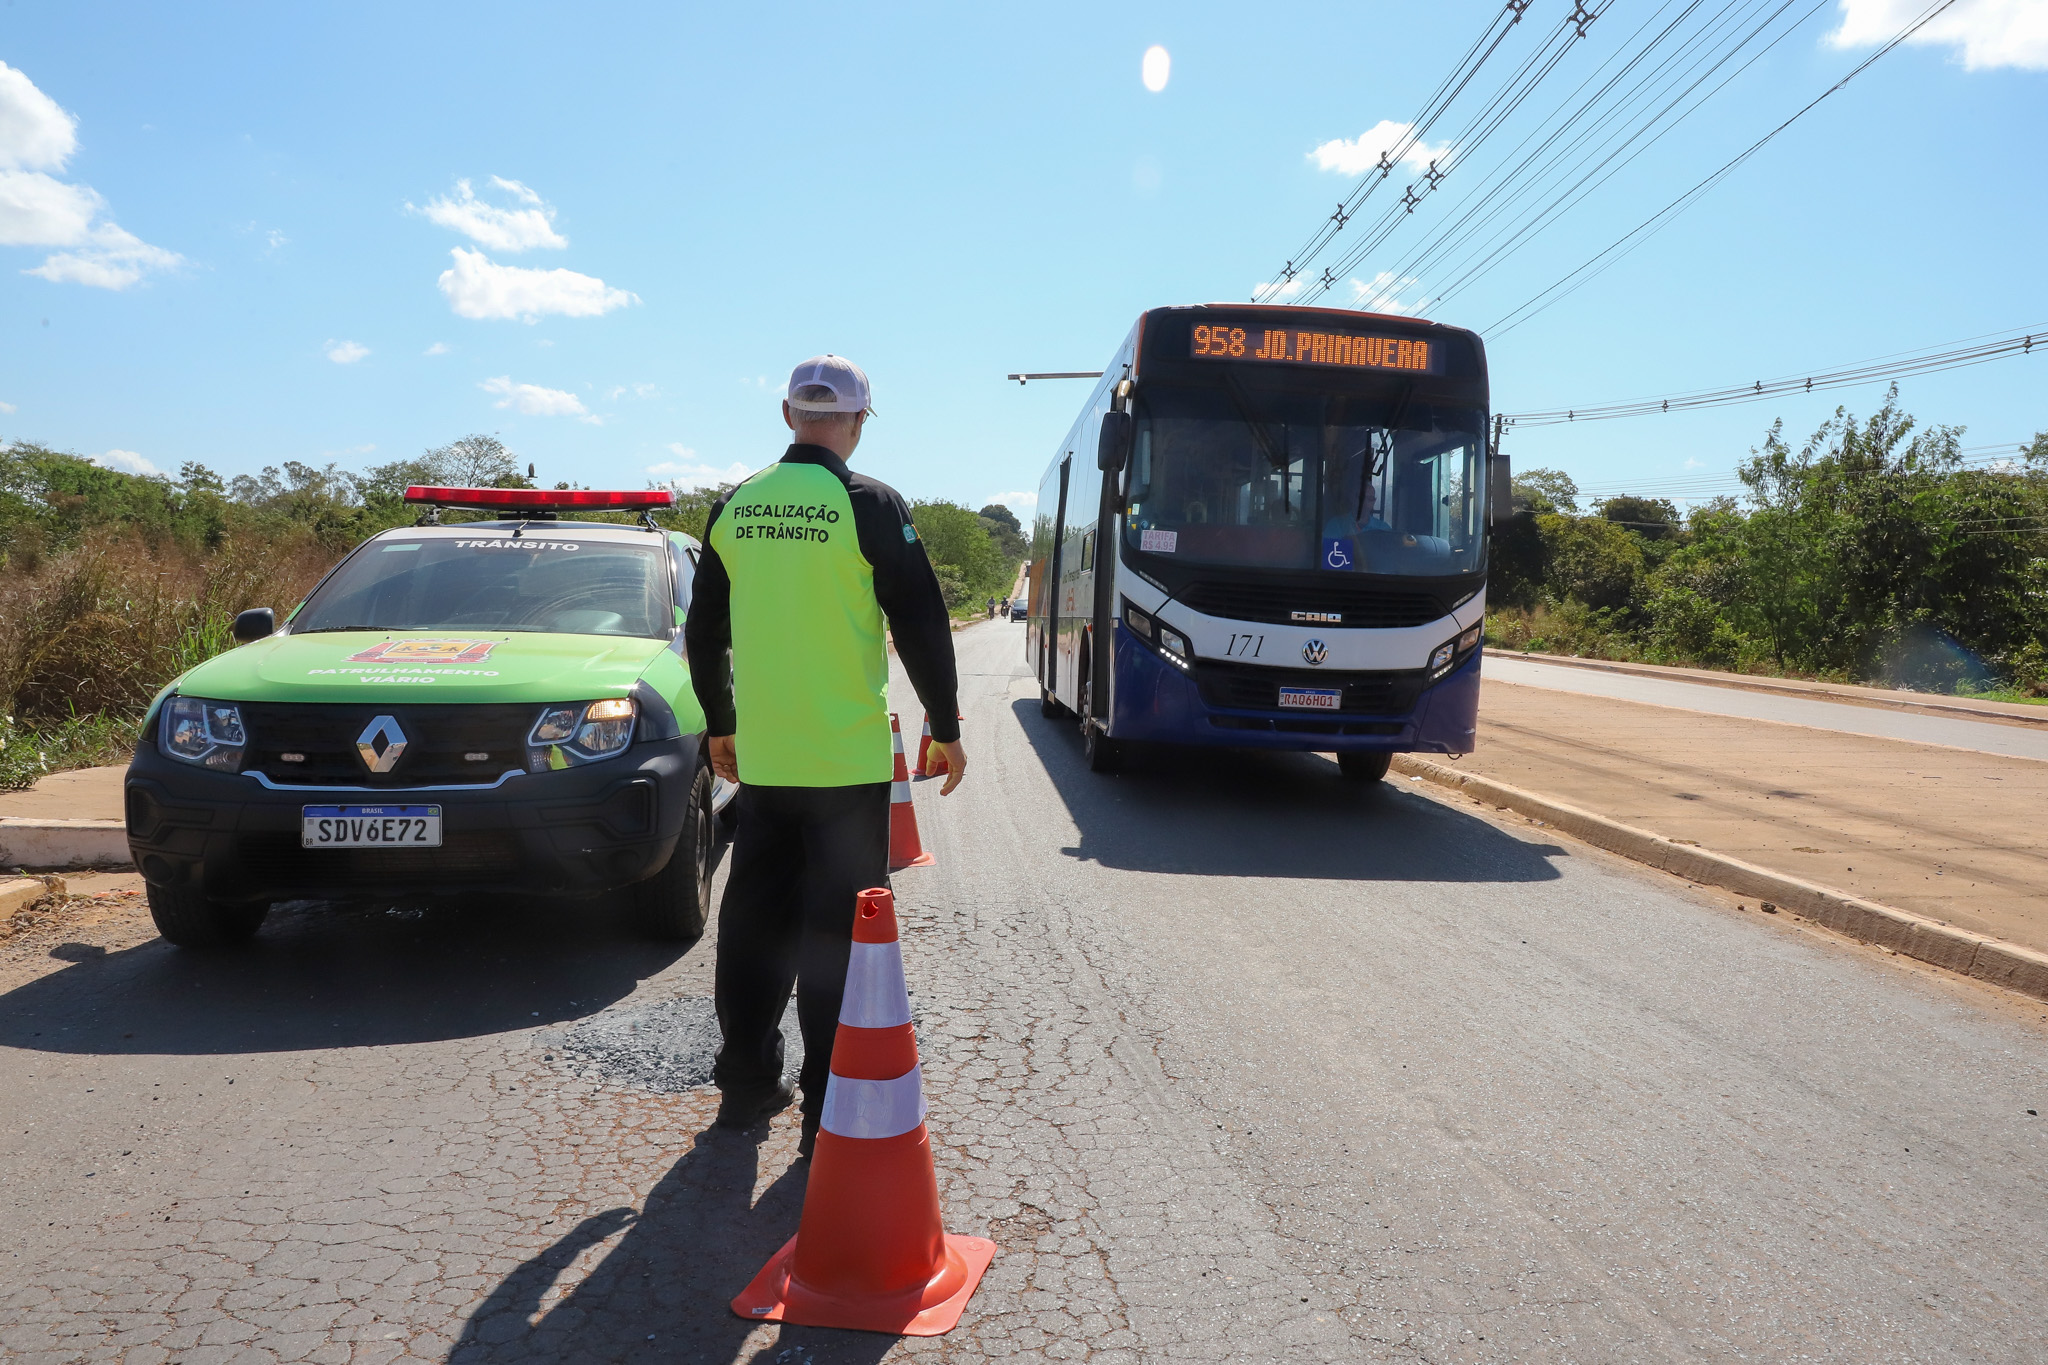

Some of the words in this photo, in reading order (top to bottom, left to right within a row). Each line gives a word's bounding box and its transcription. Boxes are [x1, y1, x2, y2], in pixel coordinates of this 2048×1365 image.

[1194, 325, 1247, 357] 958
[734, 504, 840, 524] FISCALIZAÇÃO
[736, 526, 754, 539] DE
[757, 522, 829, 543] TRÂNSITO
[1143, 531, 1175, 541] TARIFA
[454, 539, 580, 551] TRÂNSITO
[1291, 611, 1342, 622] CAIO
[1224, 633, 1264, 658] 171
[307, 668, 500, 677] PATRULHAMENTO
[360, 675, 436, 683] VIÁRIO
[318, 819, 427, 842] SDV6E72
